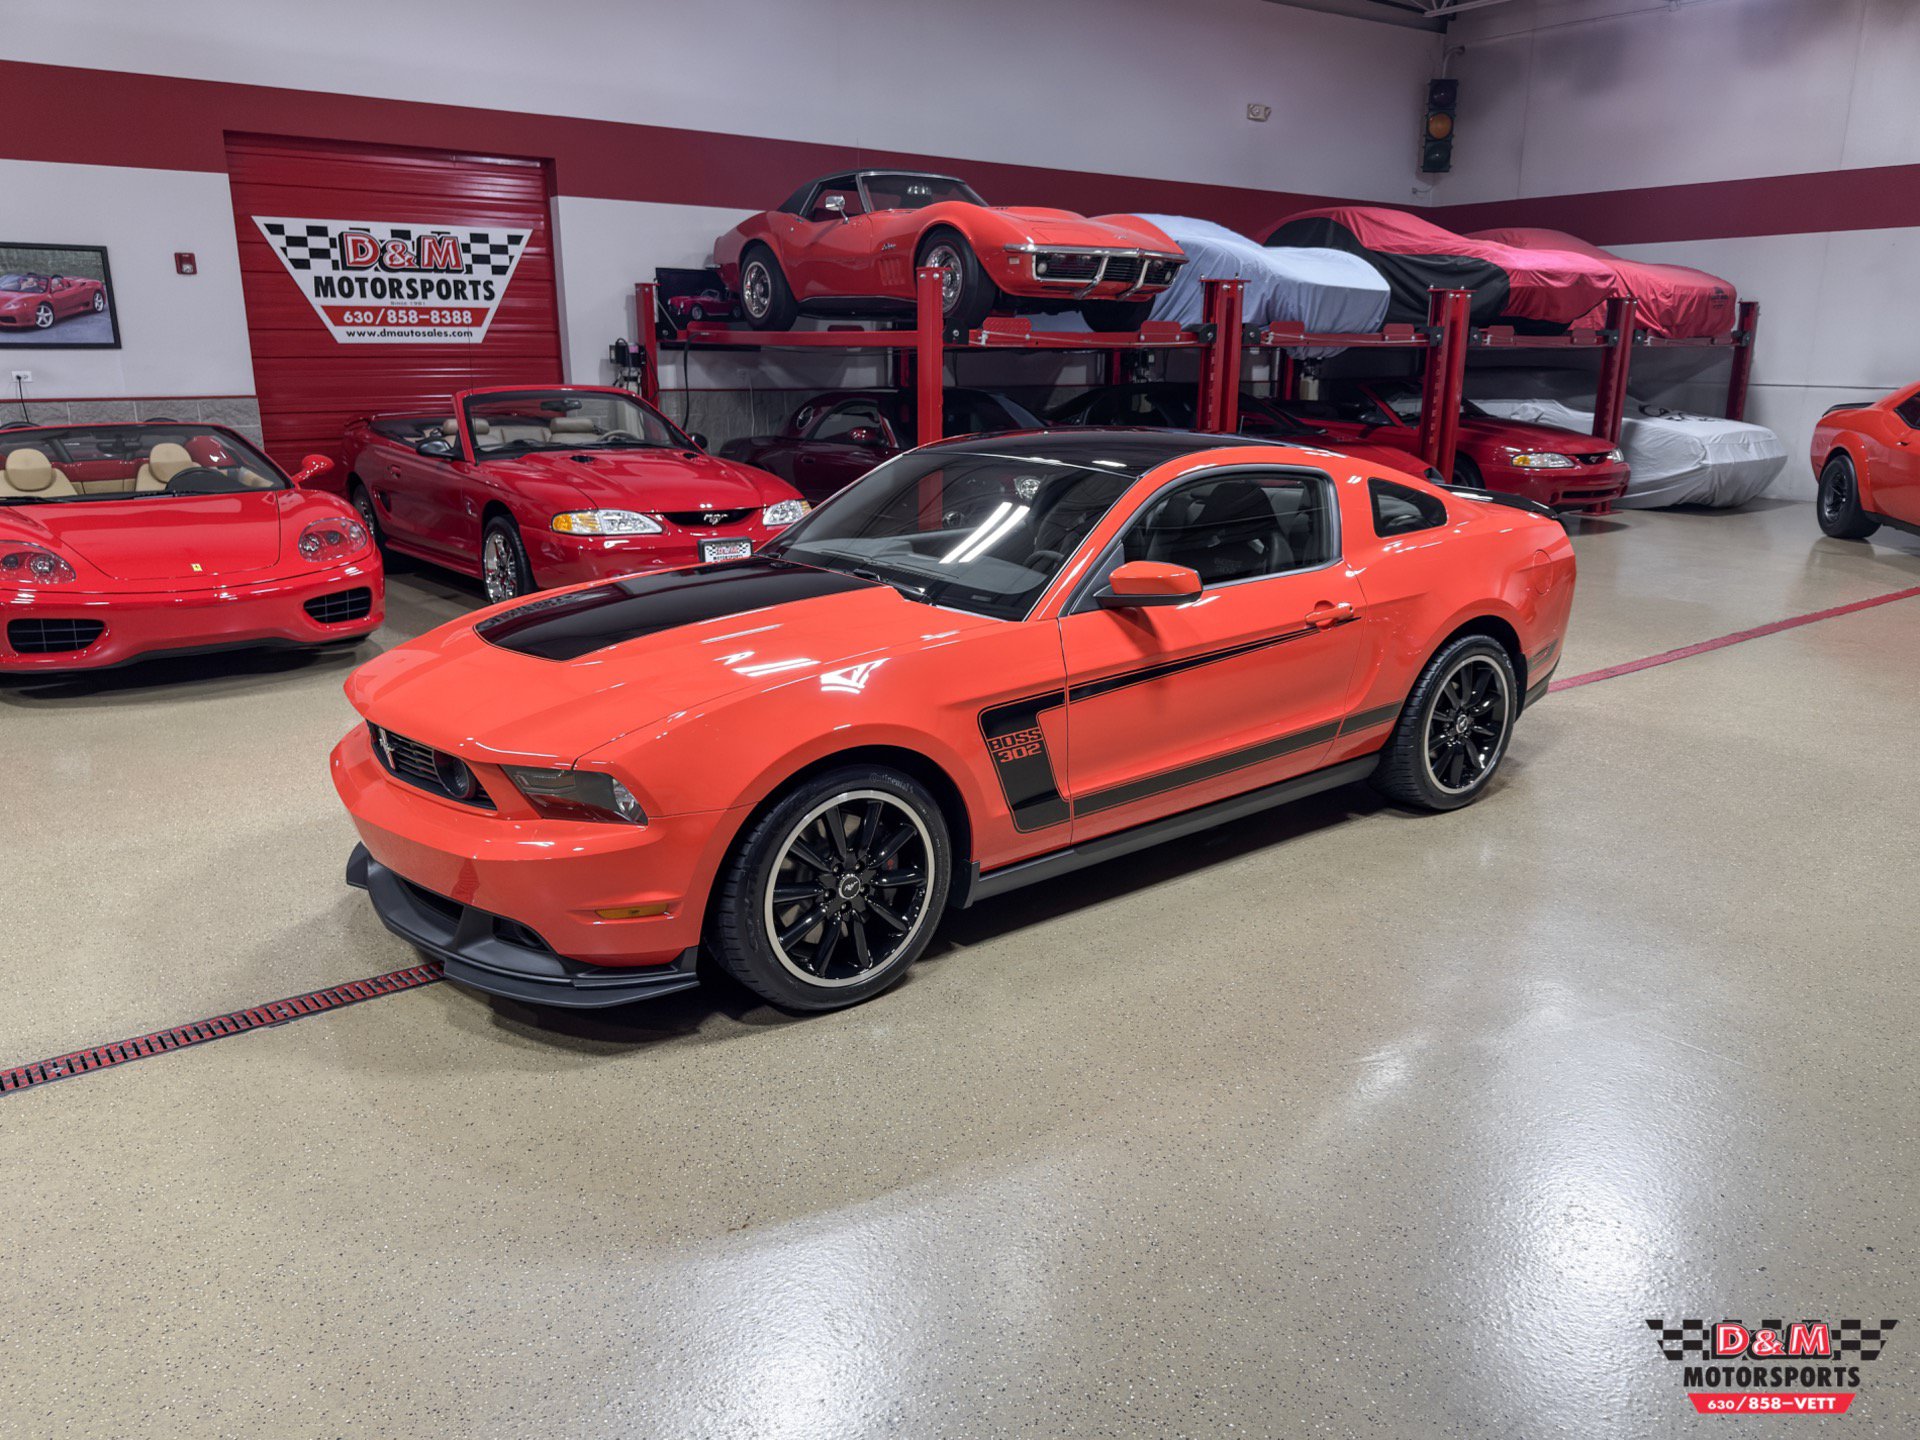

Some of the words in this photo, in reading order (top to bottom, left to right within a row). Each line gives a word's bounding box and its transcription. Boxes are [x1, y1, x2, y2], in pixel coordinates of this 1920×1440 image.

[340, 231, 464, 272] D&M
[314, 276, 495, 300] MOTORSPORTS
[346, 329, 473, 338] www.dmautosales.com
[988, 728, 1042, 751] BOSS
[998, 743, 1042, 763] 302
